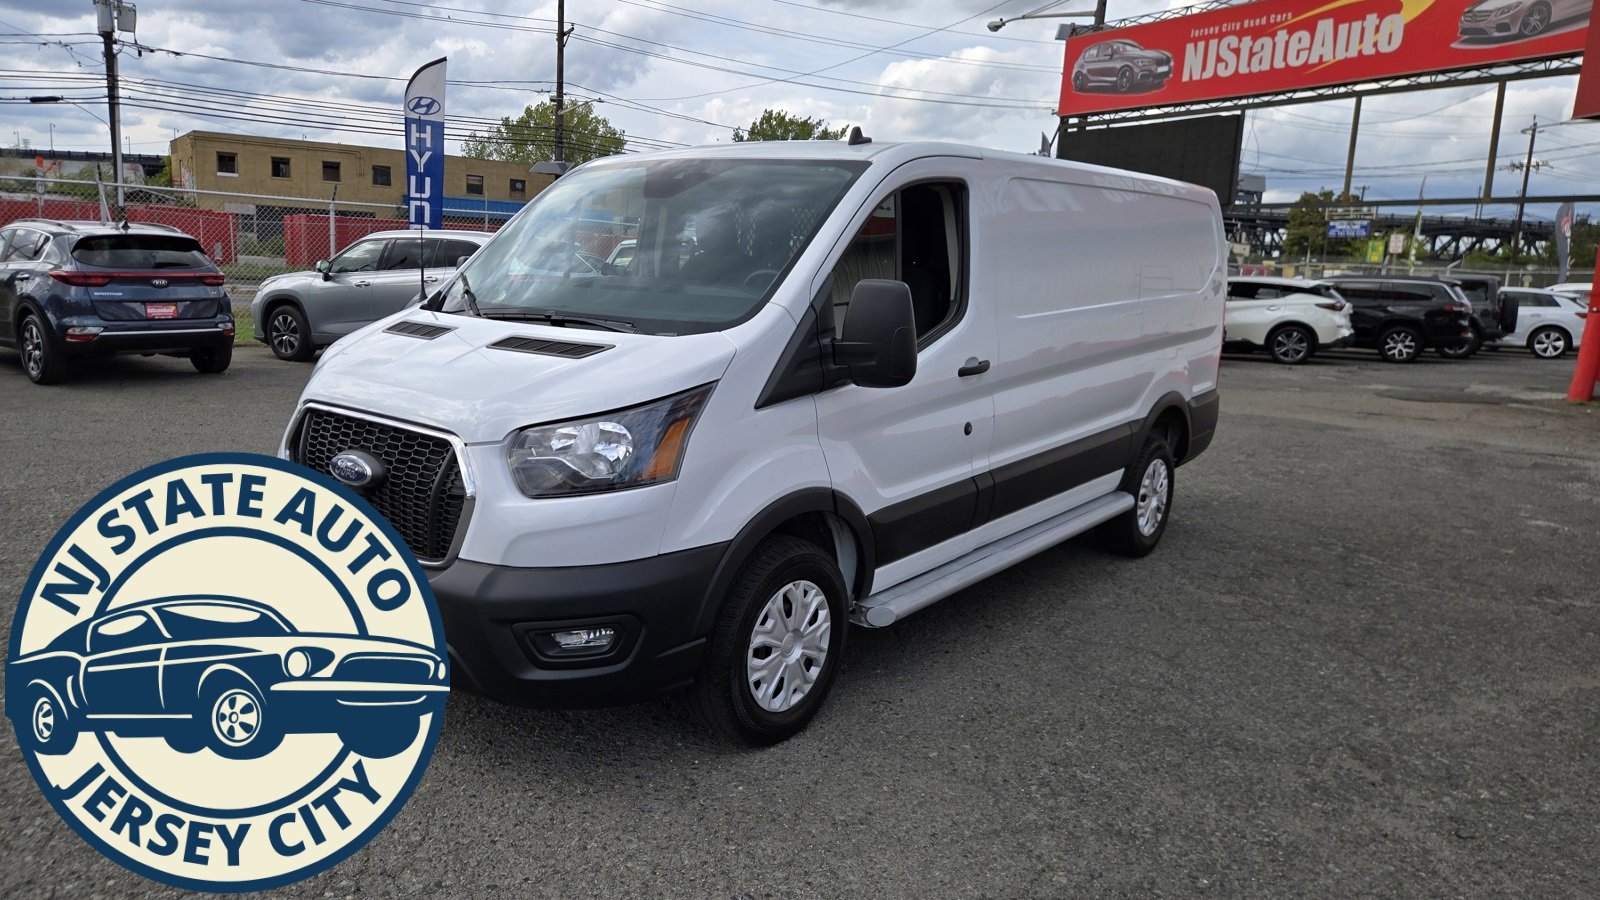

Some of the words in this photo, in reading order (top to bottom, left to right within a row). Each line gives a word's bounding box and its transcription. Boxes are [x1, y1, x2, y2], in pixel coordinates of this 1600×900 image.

[1181, 13, 1405, 82] NJStateAuto
[1190, 25, 1219, 38] Jersey
[1222, 21, 1241, 32] City
[1243, 17, 1267, 28] Used
[1269, 12, 1293, 24] Cars
